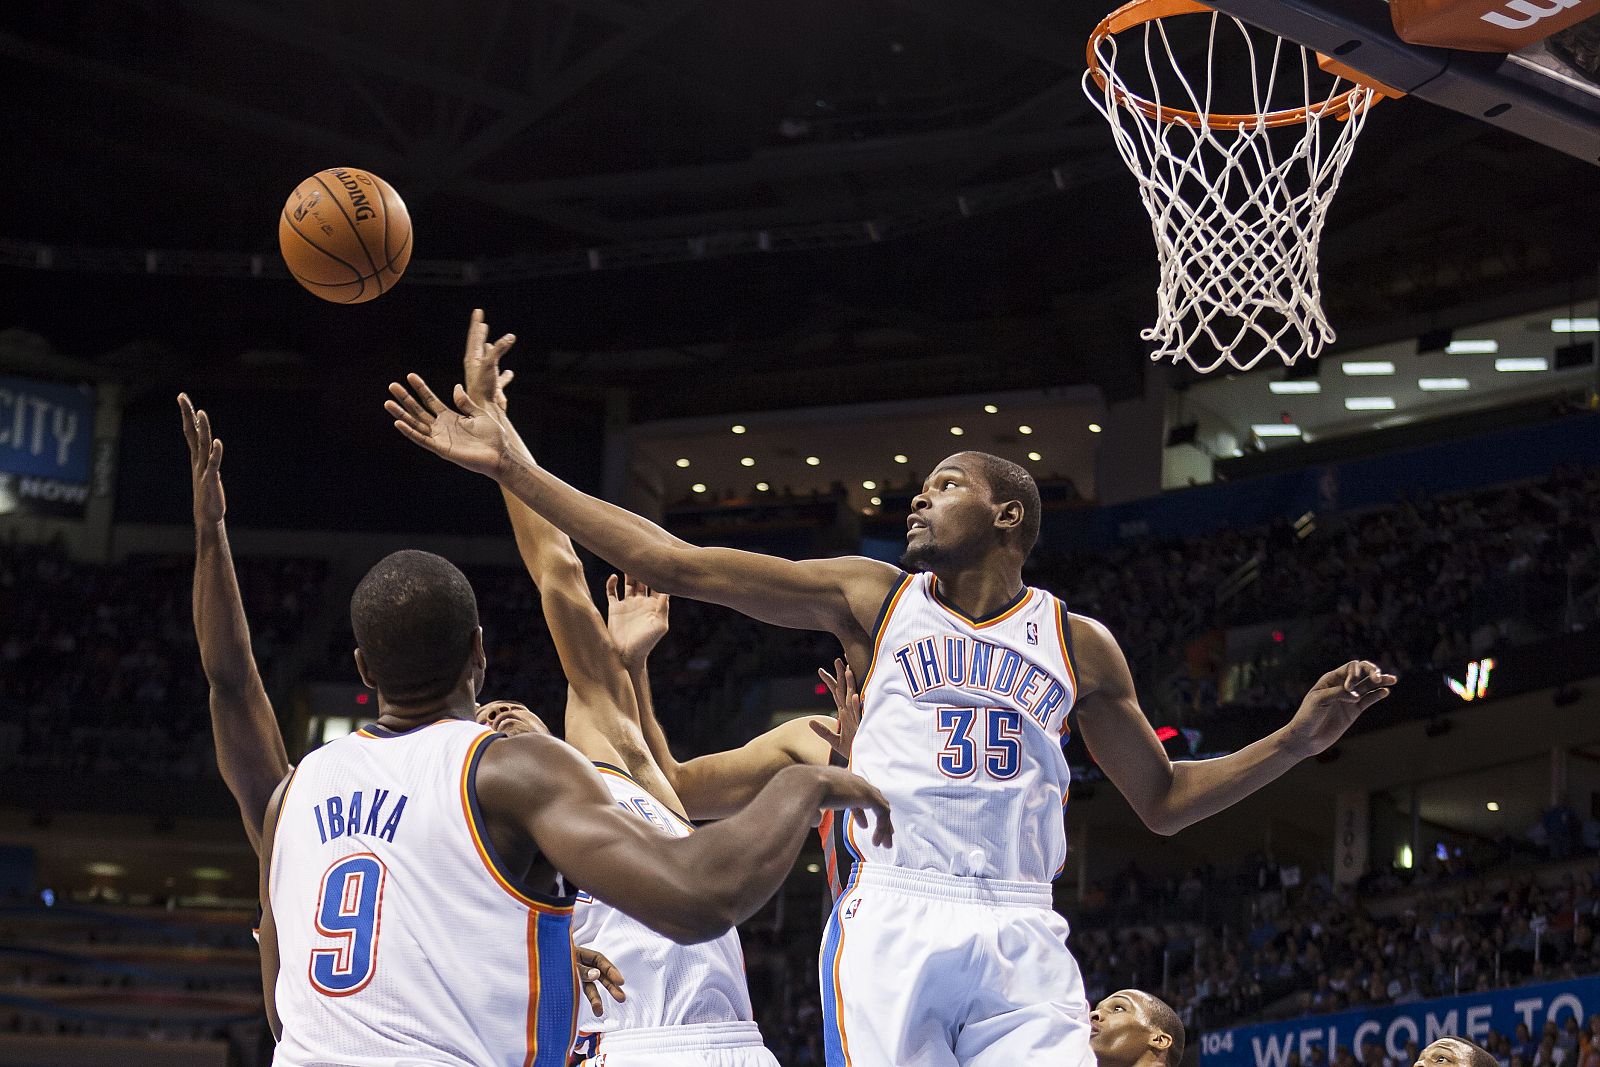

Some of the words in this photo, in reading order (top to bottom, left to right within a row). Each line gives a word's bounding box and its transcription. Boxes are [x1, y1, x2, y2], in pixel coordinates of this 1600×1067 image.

[894, 635, 1066, 731] THUNDER
[937, 707, 1023, 781] 35
[314, 789, 408, 844] IBAKA
[309, 852, 387, 997] 9
[1200, 1031, 1233, 1056] 104
